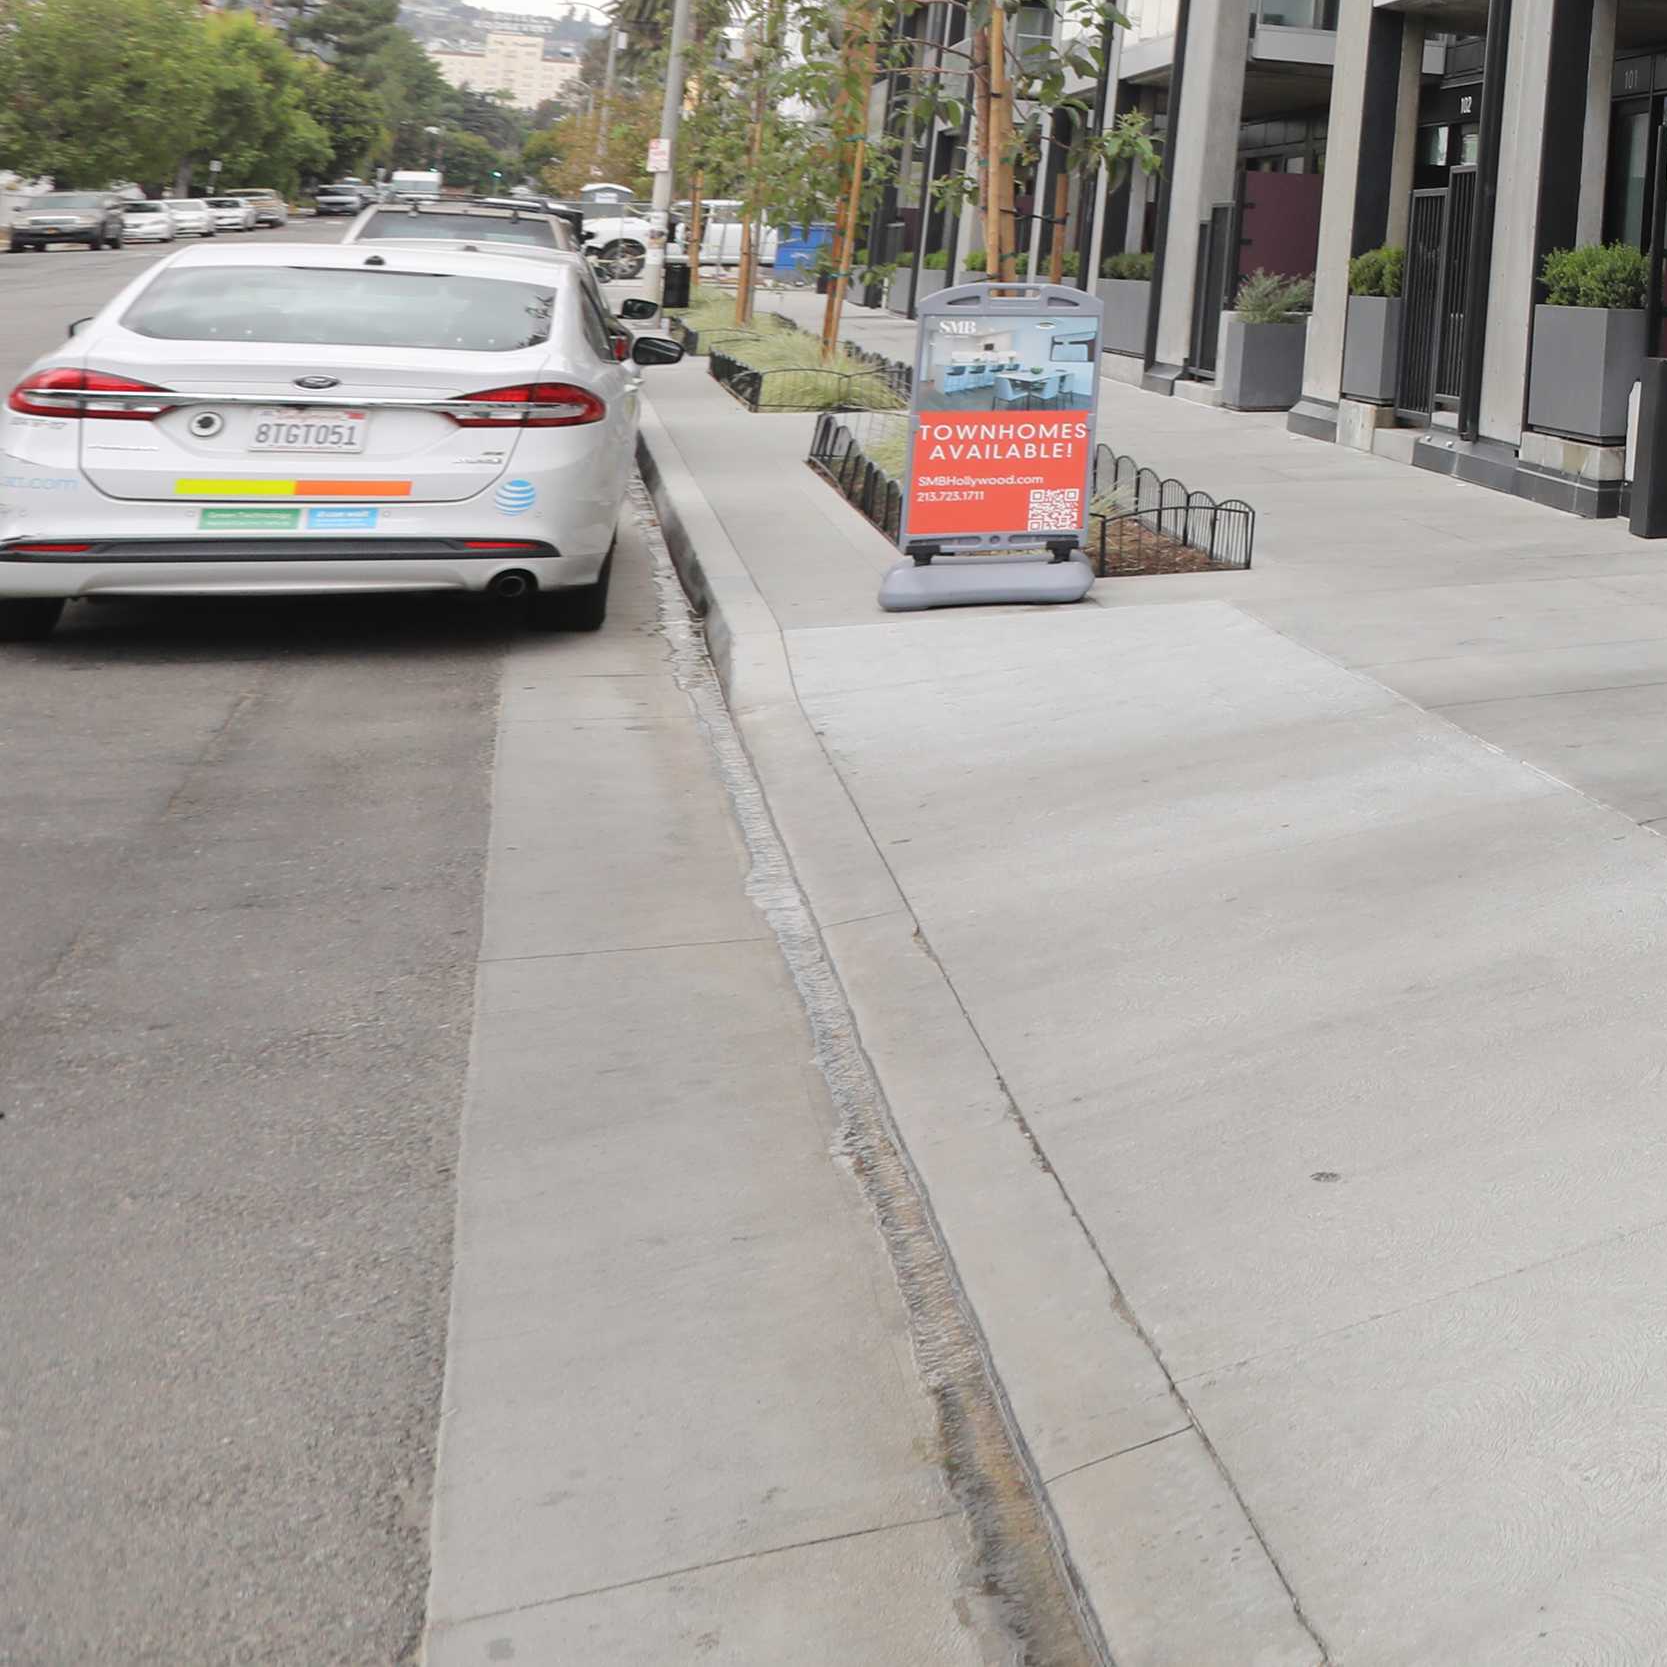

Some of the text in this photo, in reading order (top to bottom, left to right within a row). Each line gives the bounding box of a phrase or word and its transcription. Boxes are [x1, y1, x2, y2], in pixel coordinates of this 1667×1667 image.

[1624, 69, 1639, 89] 101
[938, 320, 977, 335] SMB
[255, 422, 357, 446] 8TGT051
[919, 423, 1088, 441] TOWNHOMES
[928, 442, 1073, 460] AVAILABLE!
[917, 475, 1044, 488] SMBHollywood.com
[916, 490, 985, 502] 213.723.1711
